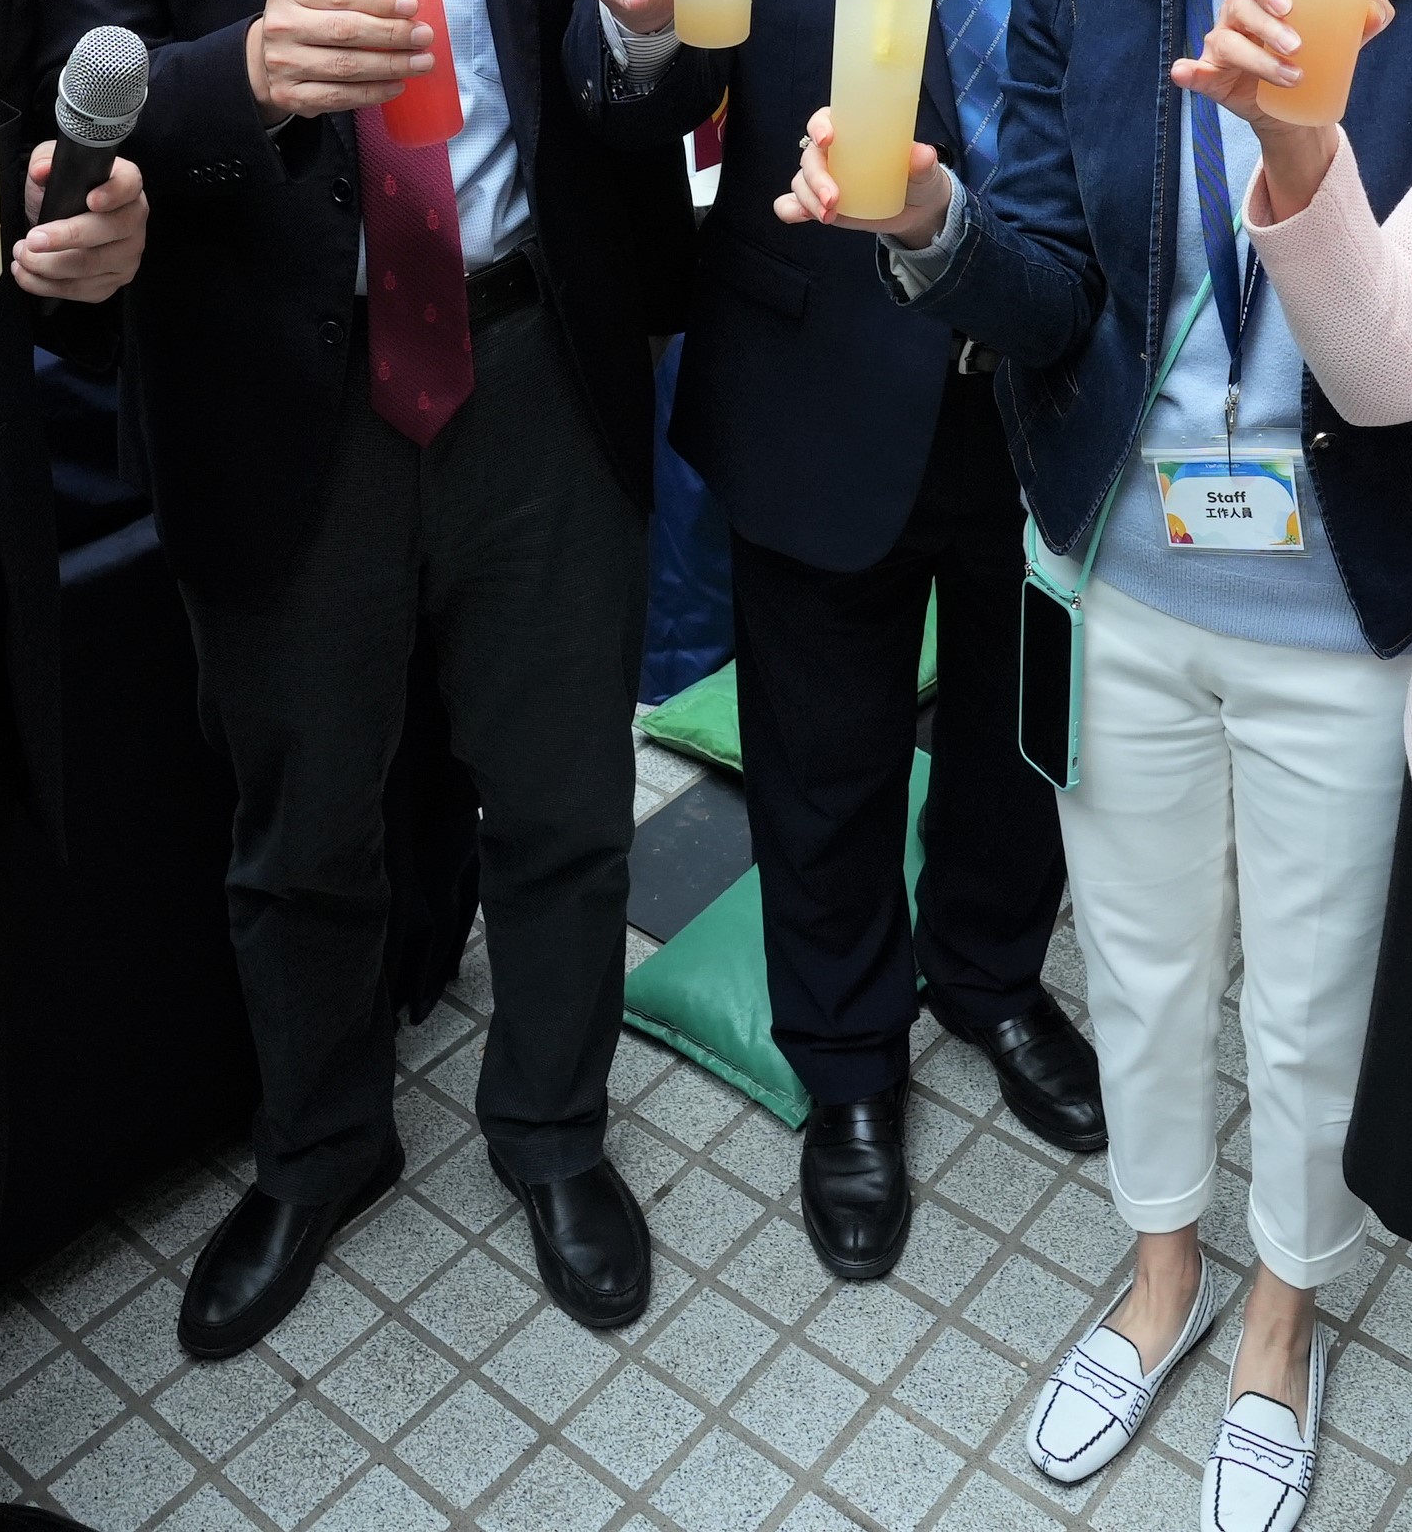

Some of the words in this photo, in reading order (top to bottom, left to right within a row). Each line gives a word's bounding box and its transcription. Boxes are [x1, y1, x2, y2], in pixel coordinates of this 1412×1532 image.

[1207, 492, 1246, 503] Staff
[1206, 508, 1253, 518] 工作人員
